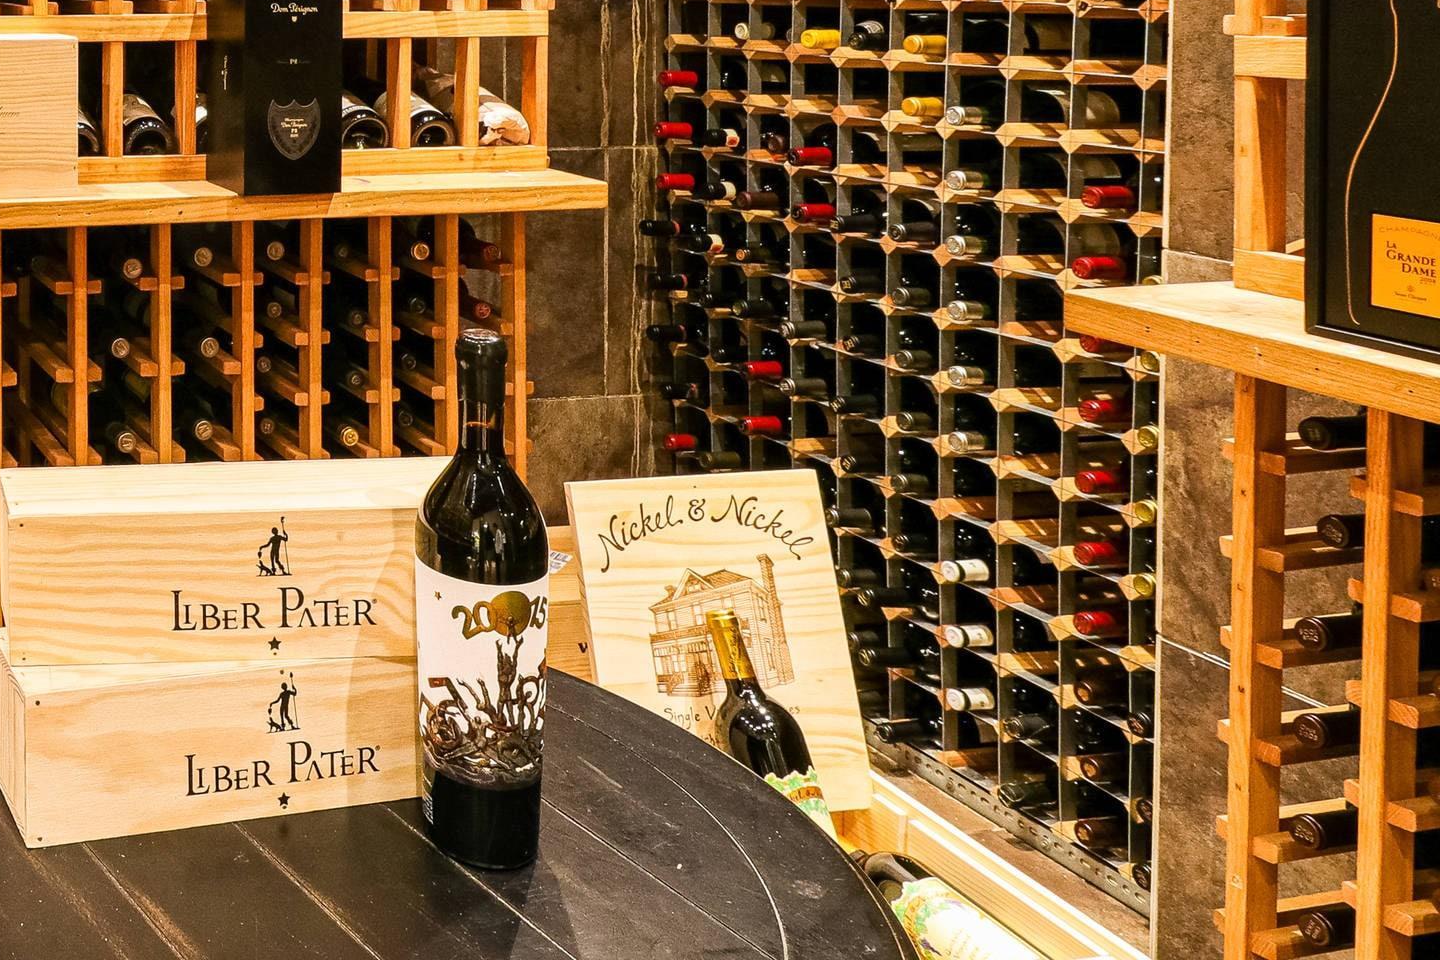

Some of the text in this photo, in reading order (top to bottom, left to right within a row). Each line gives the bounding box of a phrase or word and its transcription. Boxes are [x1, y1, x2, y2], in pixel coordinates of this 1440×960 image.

[271, 3, 289, 13] Dom
[1379, 226, 1440, 242] CHAMPAGN
[1386, 249, 1437, 267] GRANDE
[1402, 263, 1437, 279] DAME
[598, 494, 814, 573] Nickel & Nickel
[171, 589, 265, 632] LIBER
[663, 707, 701, 730] Single
[184, 753, 275, 797] LIBER
